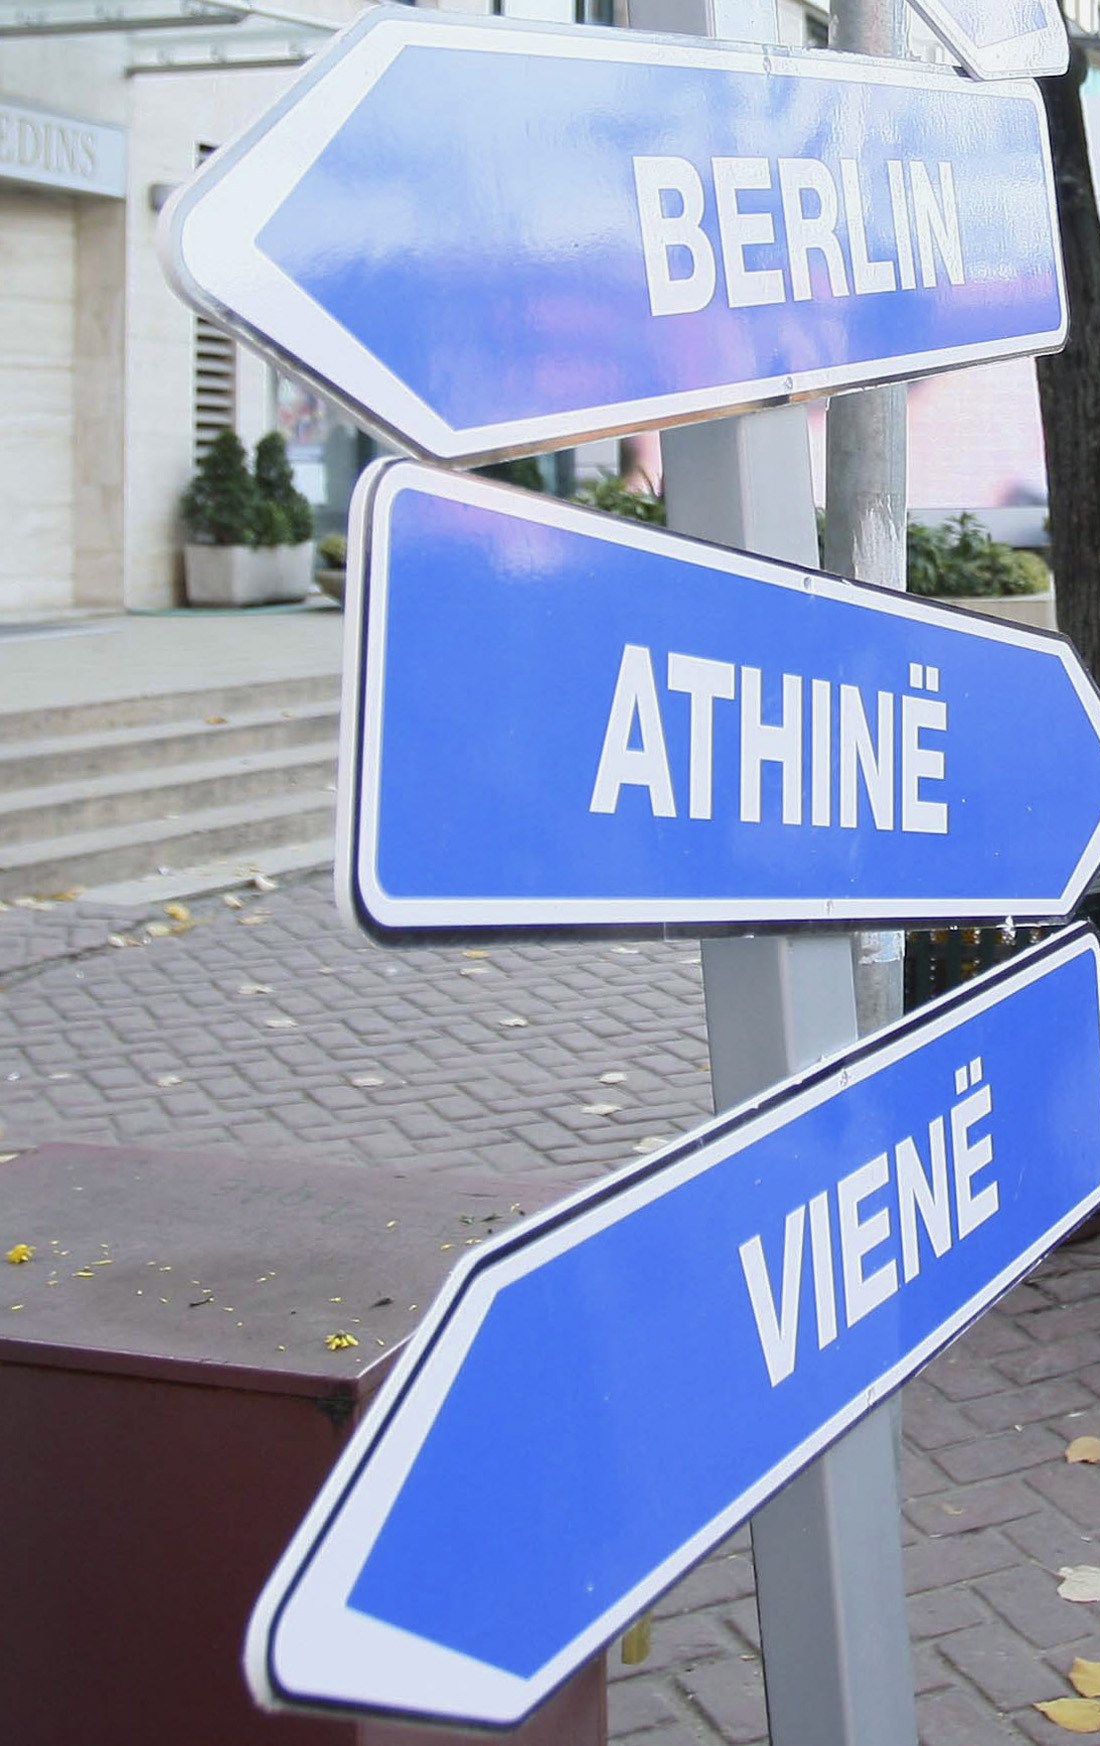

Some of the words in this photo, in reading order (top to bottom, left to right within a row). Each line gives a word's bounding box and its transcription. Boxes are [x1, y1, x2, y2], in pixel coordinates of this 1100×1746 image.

[633, 156, 966, 317] BERLIN
[589, 643, 949, 834] ATHINË
[738, 1056, 1000, 1389] VIENË
